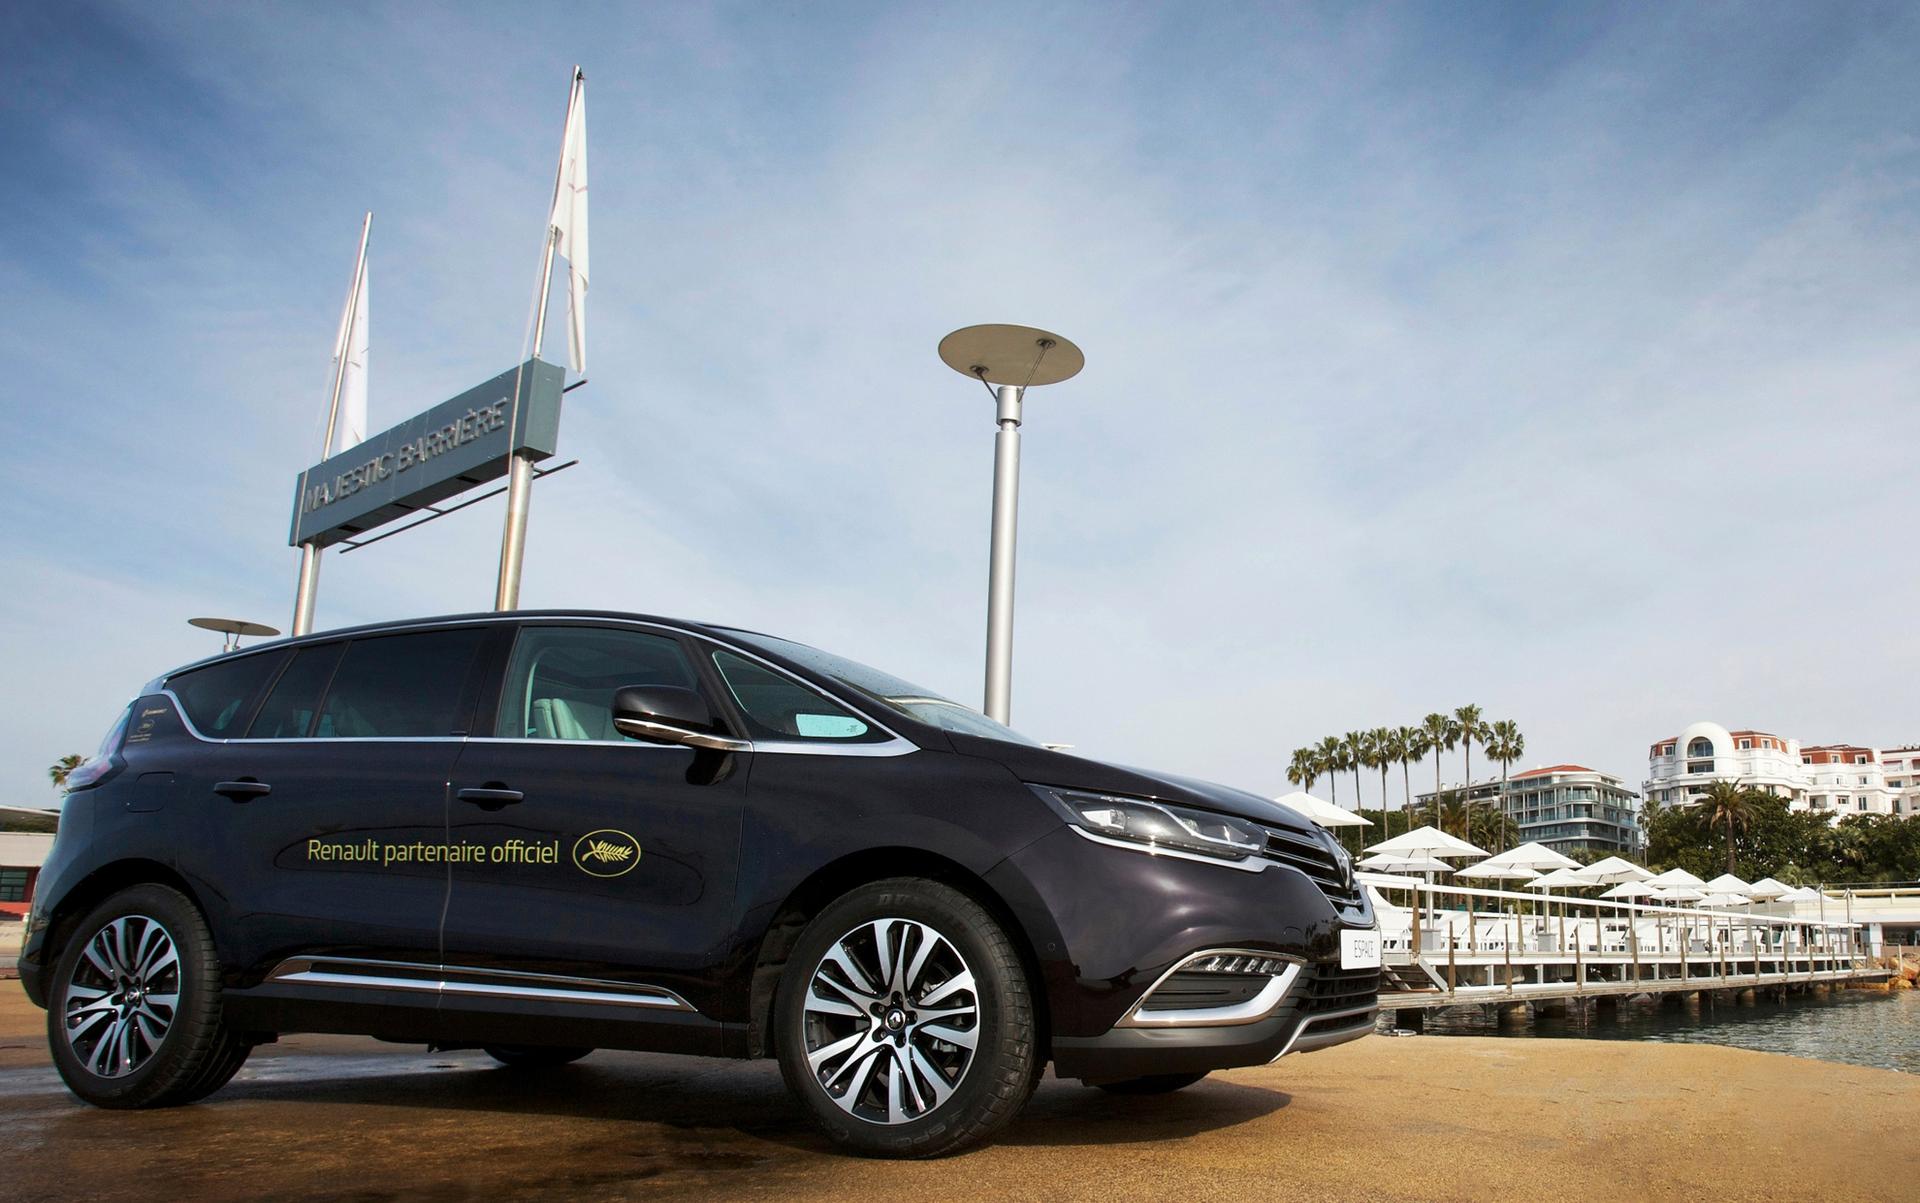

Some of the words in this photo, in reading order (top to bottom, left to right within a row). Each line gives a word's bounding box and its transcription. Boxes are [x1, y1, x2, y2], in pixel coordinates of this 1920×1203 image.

[304, 452, 395, 513] MAJESTIC
[397, 397, 508, 473] BARRIÈRE
[307, 838, 379, 862] Renault
[384, 840, 486, 867] partenaire
[491, 839, 559, 864] officiel
